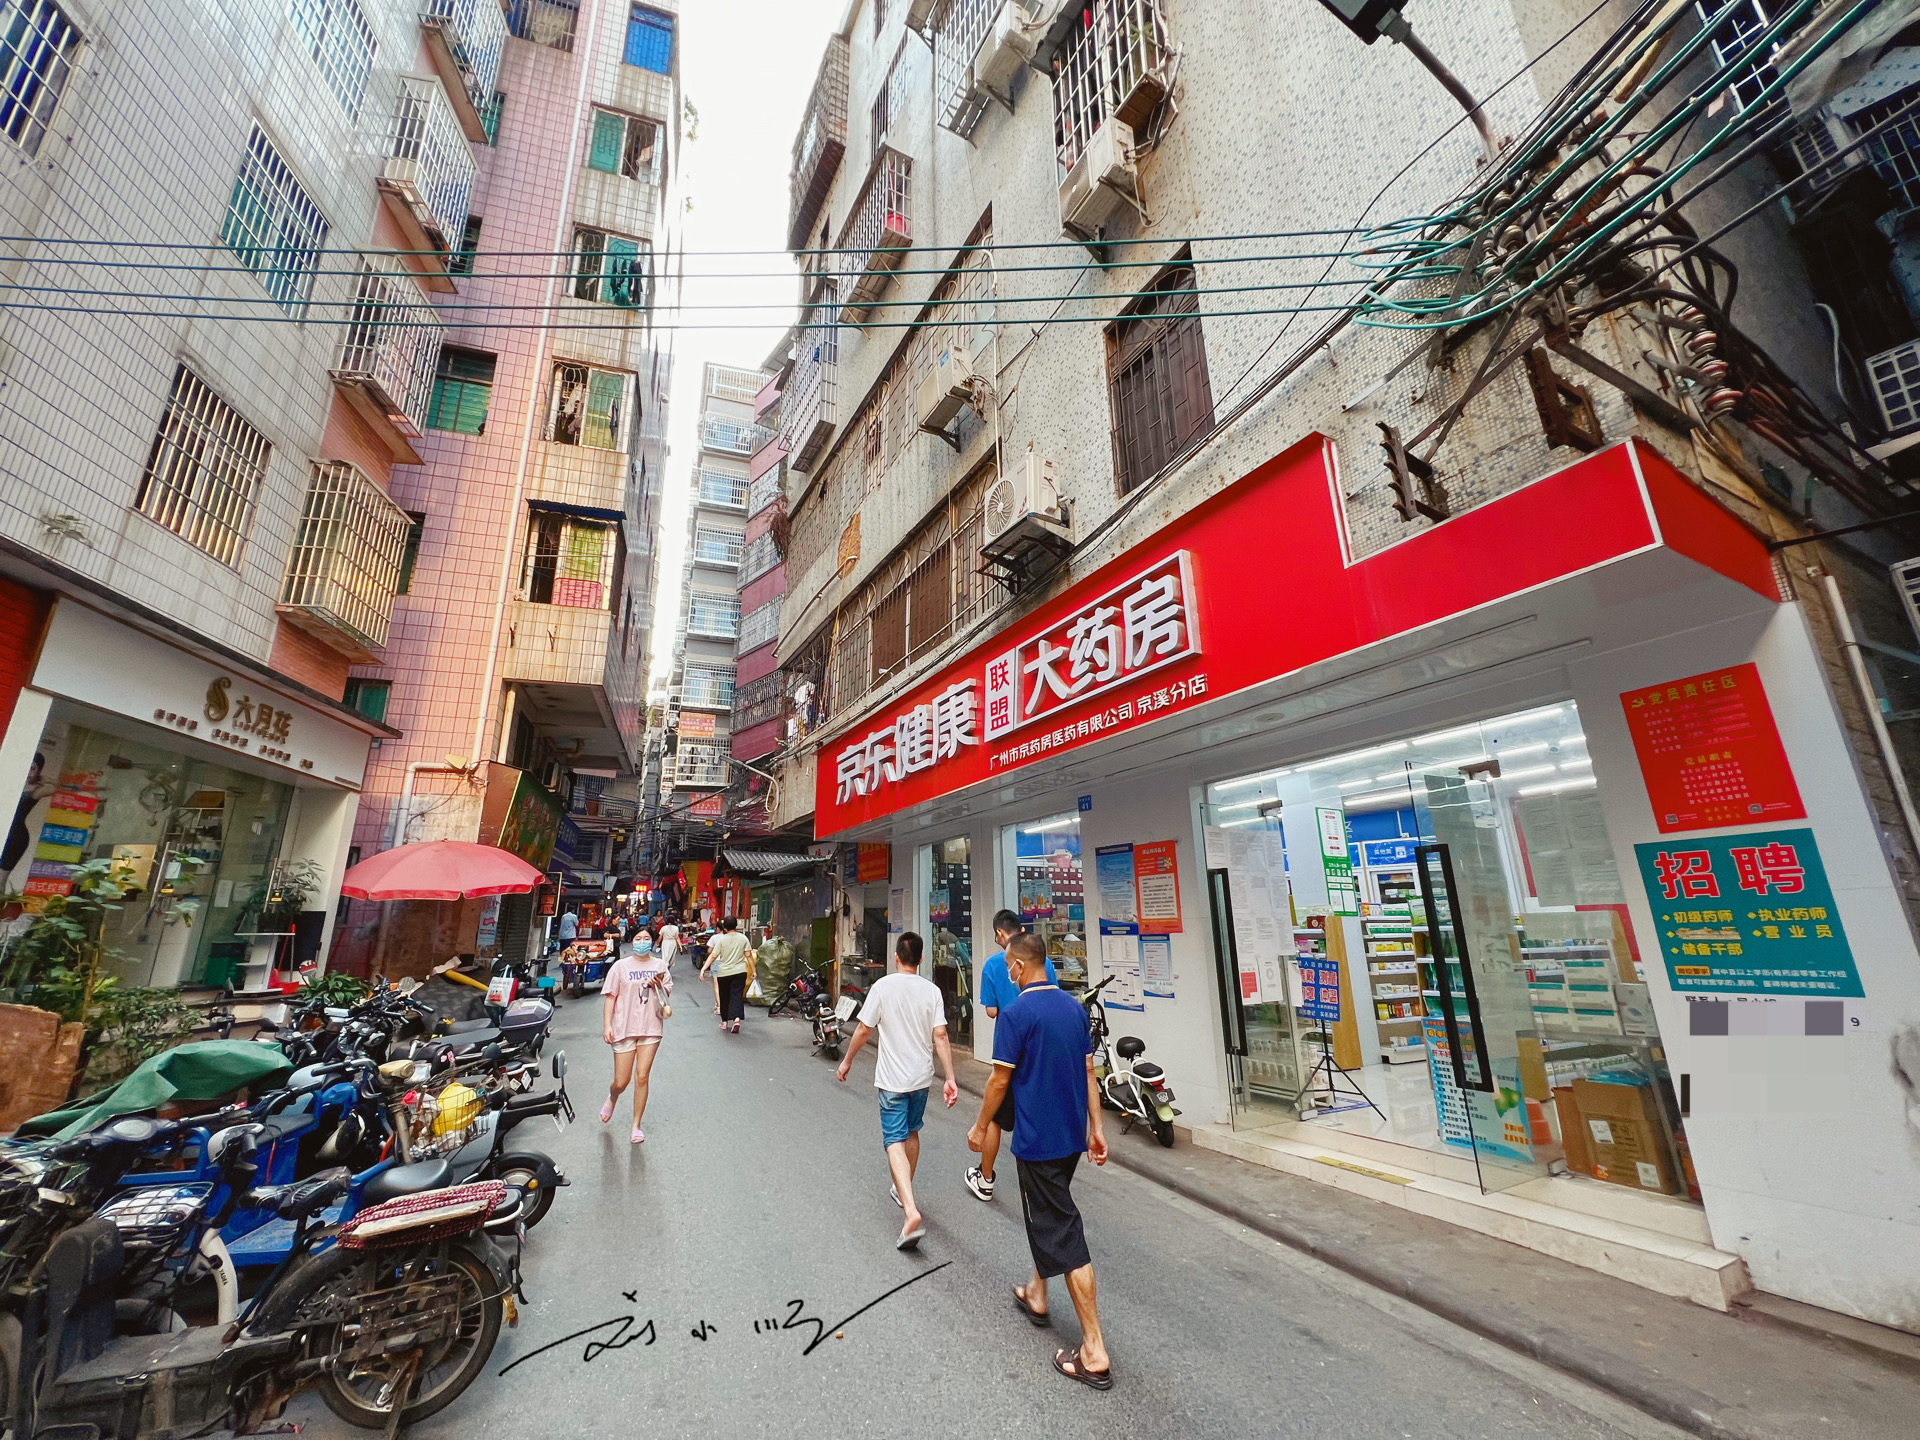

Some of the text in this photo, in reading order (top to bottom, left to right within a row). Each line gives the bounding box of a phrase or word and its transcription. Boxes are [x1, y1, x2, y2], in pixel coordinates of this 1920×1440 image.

[1023, 574, 1183, 716] 大药房
[989, 659, 1010, 731] 联盟
[1648, 674, 1737, 706] 党员责任区
[989, 673, 1208, 771] 广州市京药房医药有限公司 京溪分店
[835, 677, 978, 806] 京东健康
[1654, 842, 1806, 900] 招聘
[1673, 909, 1734, 924] 初级药师
[1758, 906, 1829, 922] 执业药师
[1762, 924, 1834, 939] 营业员
[1681, 942, 1744, 956] 储备干部
[219, 1268, 229, 1286] YADEA
